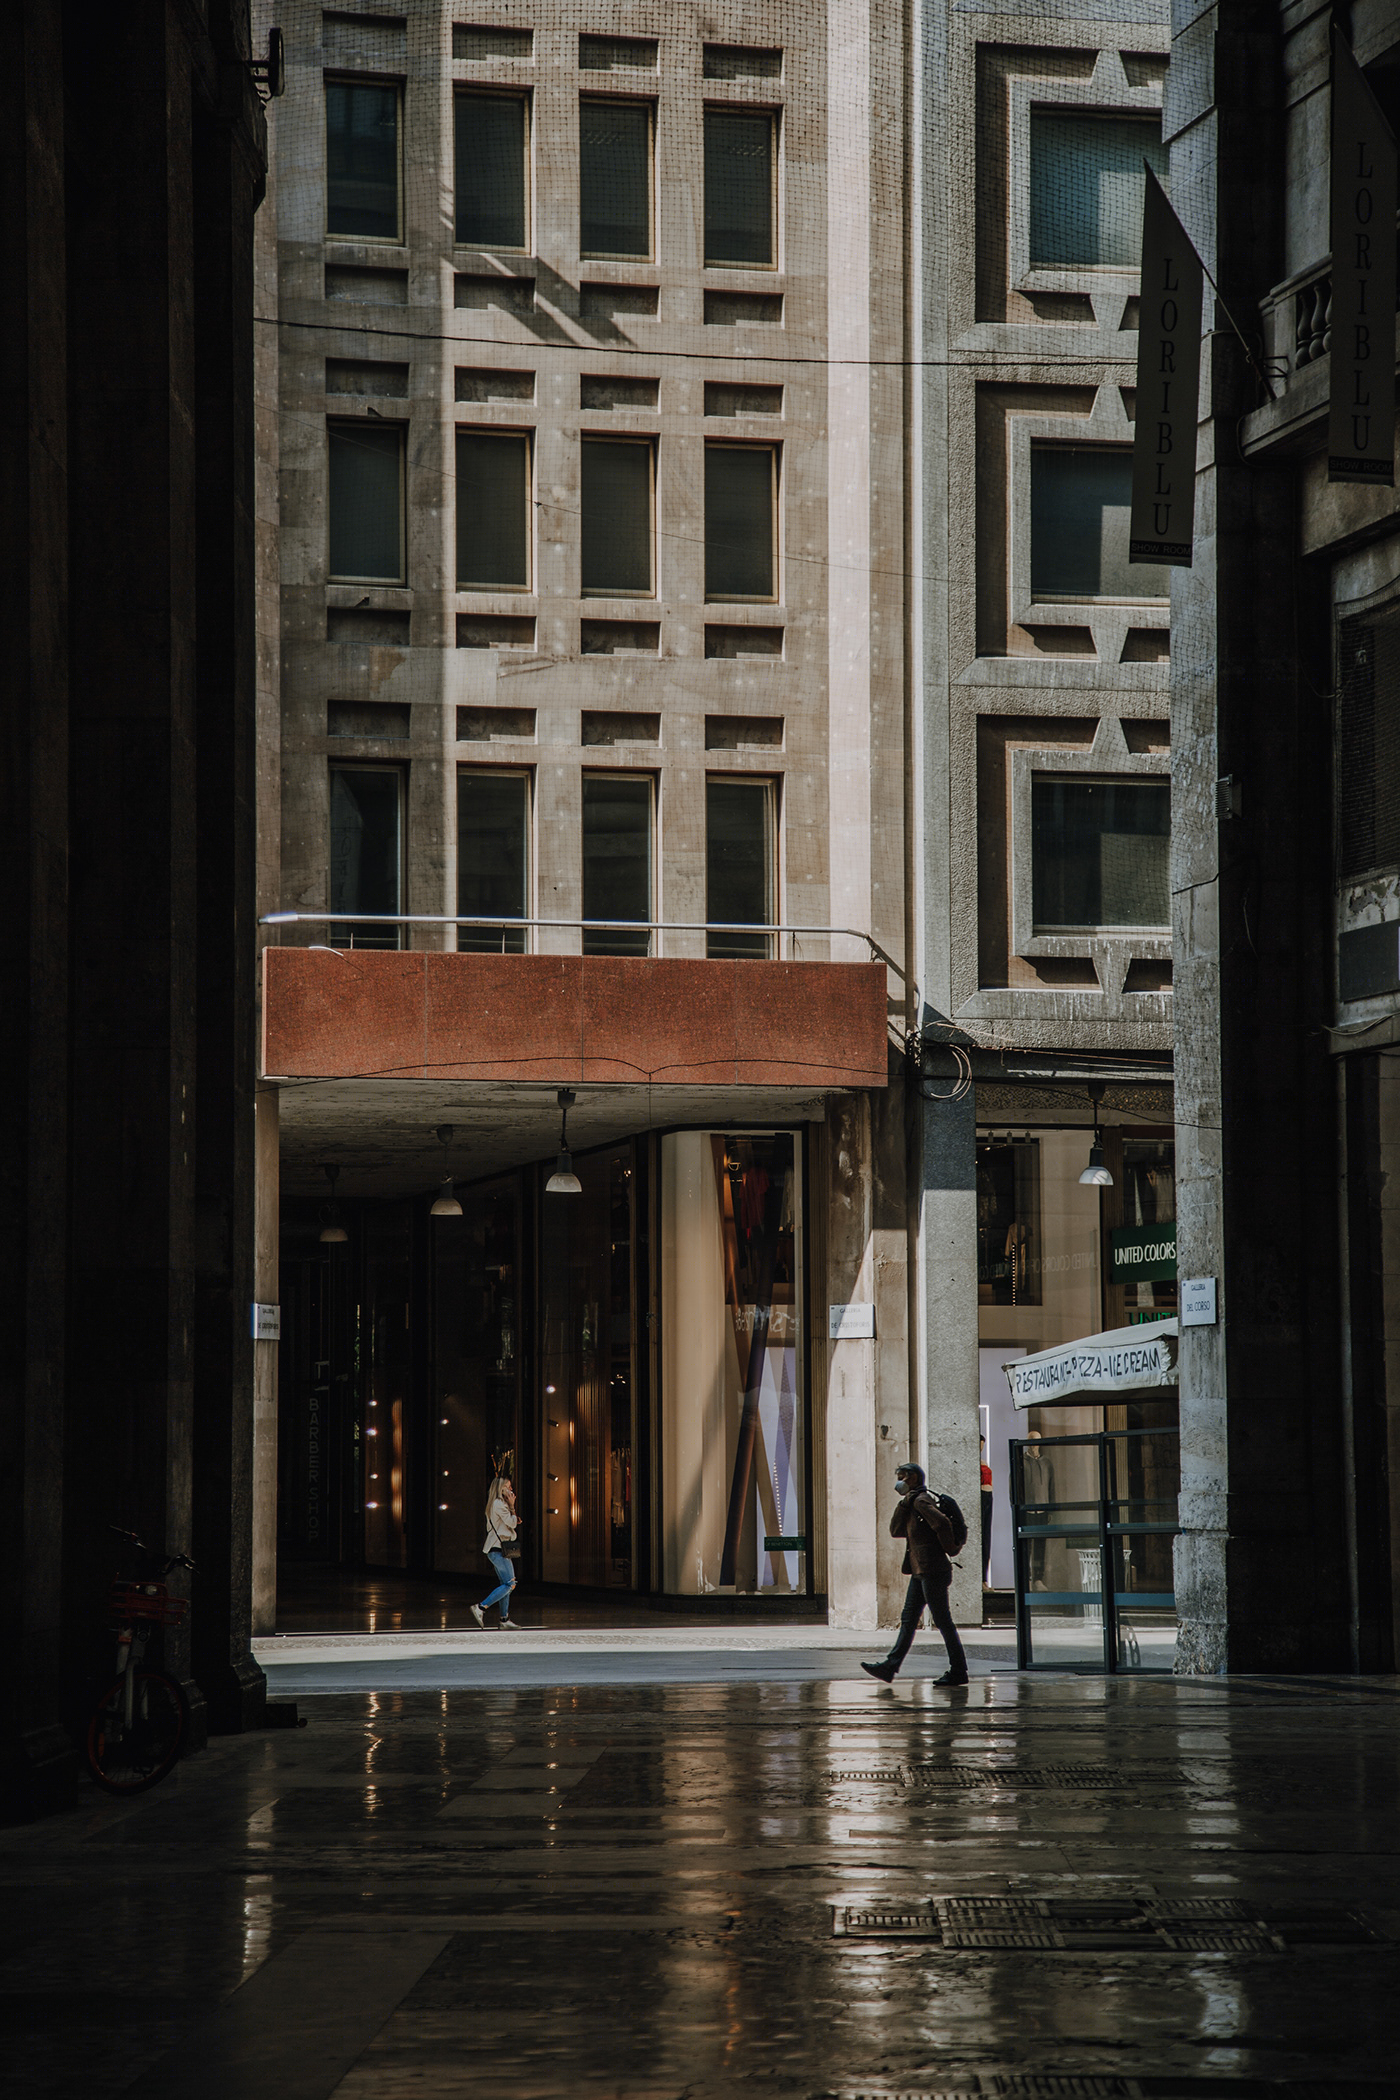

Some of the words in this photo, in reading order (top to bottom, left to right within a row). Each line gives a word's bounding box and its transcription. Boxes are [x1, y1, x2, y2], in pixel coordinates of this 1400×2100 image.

[1352, 142, 1373, 451] LORIBLU
[1153, 257, 1179, 537] LORIBLU
[1330, 459, 1359, 472] SHOW
[1363, 461, 1393, 473] ROOM
[1130, 541, 1160, 555] SHOW
[1163, 543, 1191, 556] ROOM
[1114, 1245, 1143, 1265] UNITED
[1144, 1241, 1176, 1262] COLORS
[1194, 1300, 1211, 1312] CORSO
[309, 1397, 320, 1484] BARBER
[308, 1487, 319, 1543] SHOP
